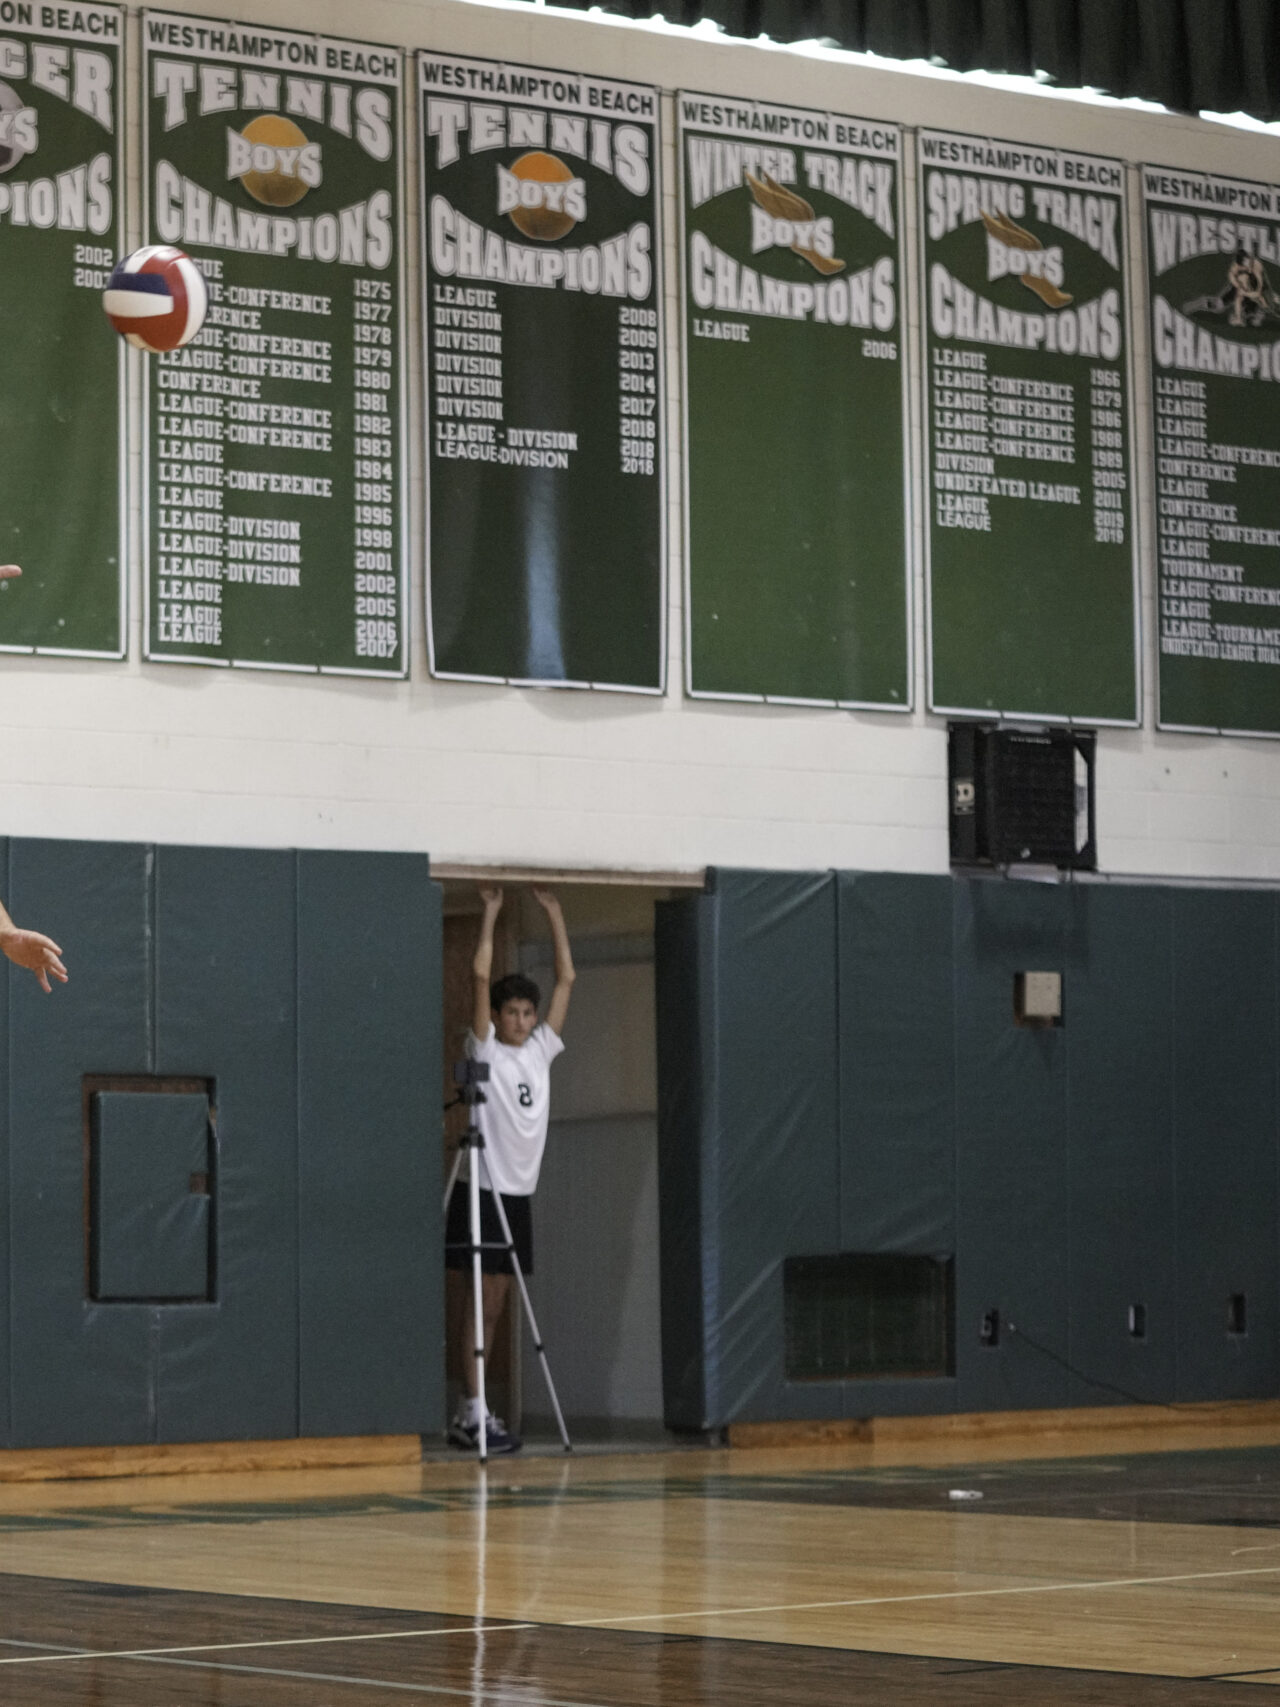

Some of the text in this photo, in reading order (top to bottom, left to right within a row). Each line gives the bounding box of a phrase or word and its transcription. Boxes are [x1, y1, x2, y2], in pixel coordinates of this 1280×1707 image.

[41, 7, 118, 36] BEACH
[148, 21, 397, 78] WESTHAMPTON BEACH
[423, 62, 654, 116] WESTHAMPTON BEACH
[154, 58, 392, 162] TENNIS
[683, 101, 896, 152] WESTHAMPTON BEACH
[227, 126, 322, 188] BOYS
[427, 96, 650, 197] TENNIS
[922, 138, 1121, 187] WESTHAMPTON BEACH
[497, 163, 586, 222] BOYS
[688, 135, 895, 239] WINTER TRACK
[1145, 174, 1271, 212] WESTHAMPTON
[156, 160, 392, 270] CHAMPIONS
[751, 202, 834, 258] BOYS
[927, 170, 1120, 271] SPRING TRACK
[76, 245, 112, 266] 2002
[431, 194, 652, 300] CHAMPIONS
[987, 231, 1064, 288] BOYS
[355, 280, 390, 300] 1975
[435, 285, 496, 308] LEAGUE
[691, 230, 895, 332] CHAMPIONS
[355, 302, 392, 322] 1977
[435, 307, 501, 330] DIVISION
[930, 262, 1121, 361] CHAMPIONS
[694, 319, 749, 342] LEAGUE
[355, 347, 391, 367] 1979
[934, 348, 986, 370] LEAGUE
[158, 370, 387, 412] CONFERENCE 1981
[1157, 378, 1206, 398] LEAGUE
[438, 397, 503, 420] DIVISION
[1158, 398, 1206, 418] LEAGUE
[159, 440, 223, 462] LEAGUE
[436, 422, 495, 442] LEAGUE
[508, 428, 577, 450] DIVISION
[935, 472, 1026, 498] UNDEFEATED
[1029, 482, 1080, 504] LEAGUE
[936, 493, 989, 515] LEAGUE
[159, 509, 392, 548] LEAGUE-DIVISION 1998
[356, 506, 392, 525] 1996
[356, 551, 392, 571] 2001
[356, 574, 395, 594] 2002
[356, 597, 395, 616] 2005
